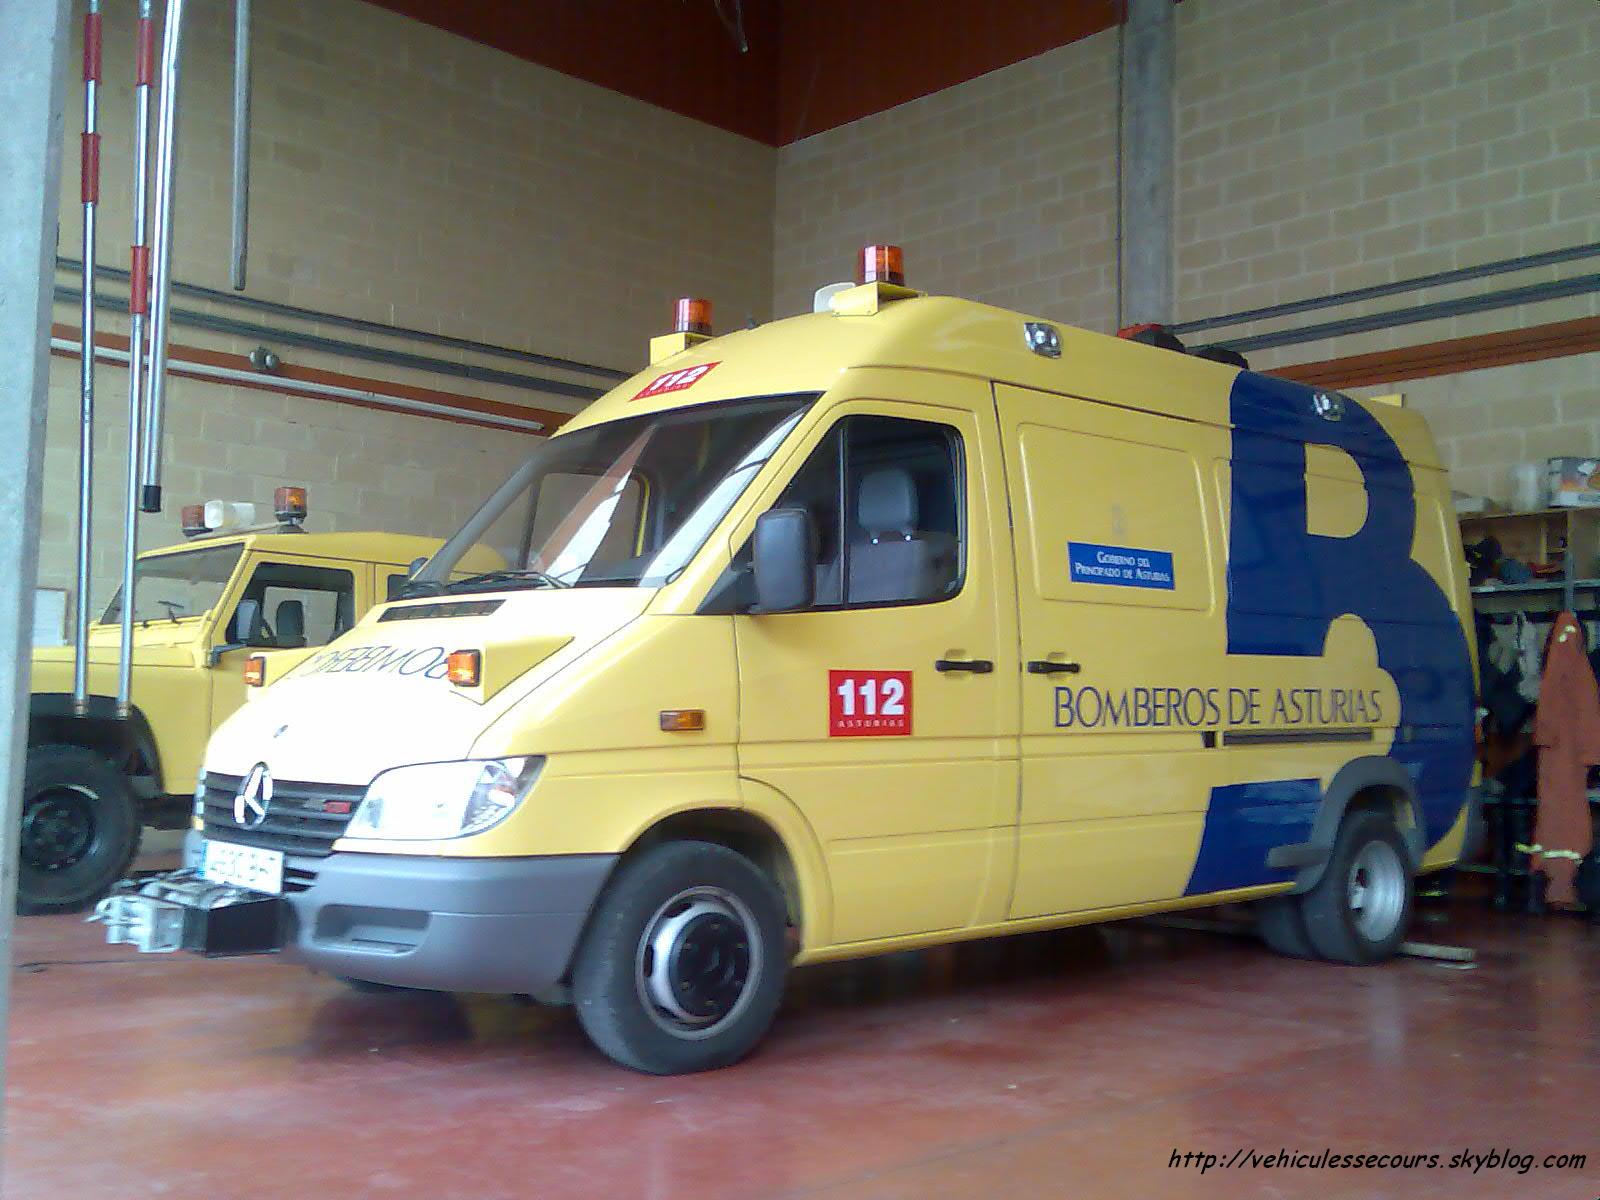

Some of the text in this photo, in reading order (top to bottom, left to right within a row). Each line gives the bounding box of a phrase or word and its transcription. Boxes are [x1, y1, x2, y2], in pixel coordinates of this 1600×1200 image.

[648, 364, 710, 391] 112
[837, 677, 905, 716] 112
[1054, 685, 1383, 728] BOMBEROS DE ASTURIAS
